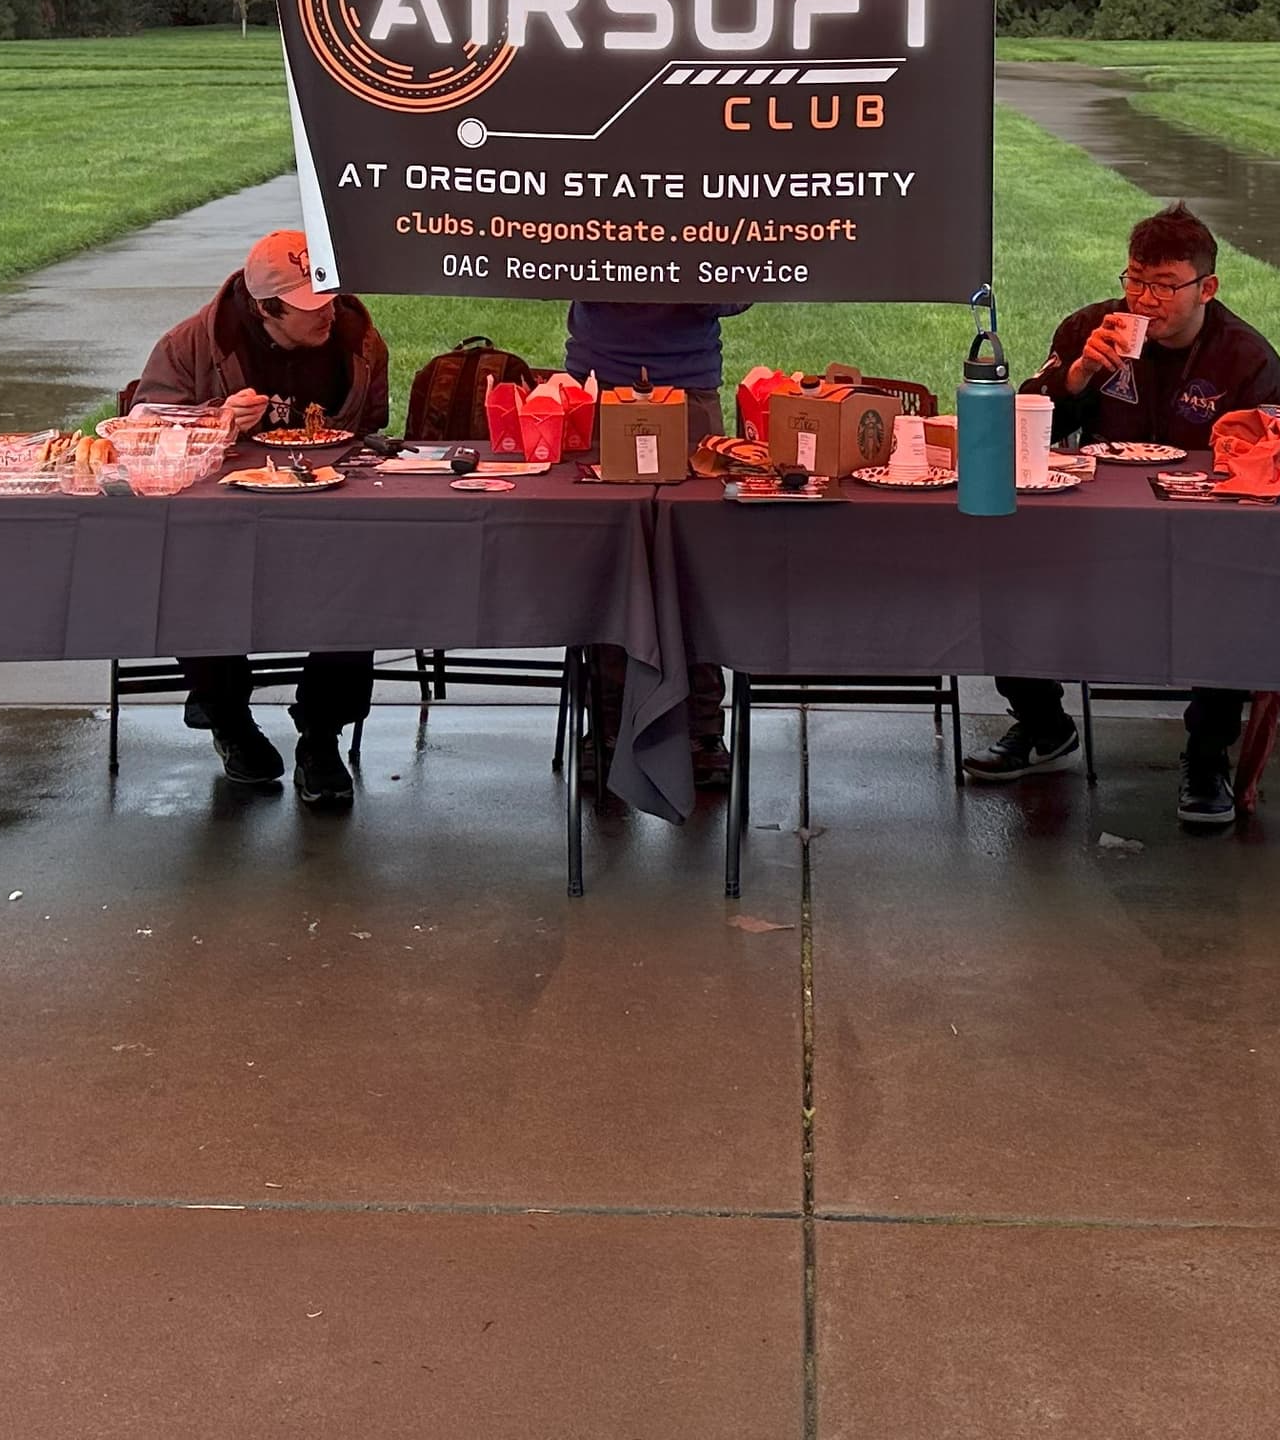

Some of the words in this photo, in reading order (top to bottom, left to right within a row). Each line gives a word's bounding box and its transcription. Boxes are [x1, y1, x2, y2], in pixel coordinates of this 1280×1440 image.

[724, 95, 885, 131] CLUB
[338, 162, 388, 189] AT
[406, 165, 546, 196] OREGON
[564, 172, 684, 199] STATE
[702, 171, 916, 199] UNIVERSITY
[396, 211, 857, 245] clubs.OregonState.edu/Airsoft
[443, 254, 489, 278] OAC
[506, 257, 681, 283] Recruitment
[698, 259, 809, 283] Service
[1179, 391, 1216, 411] NASA
